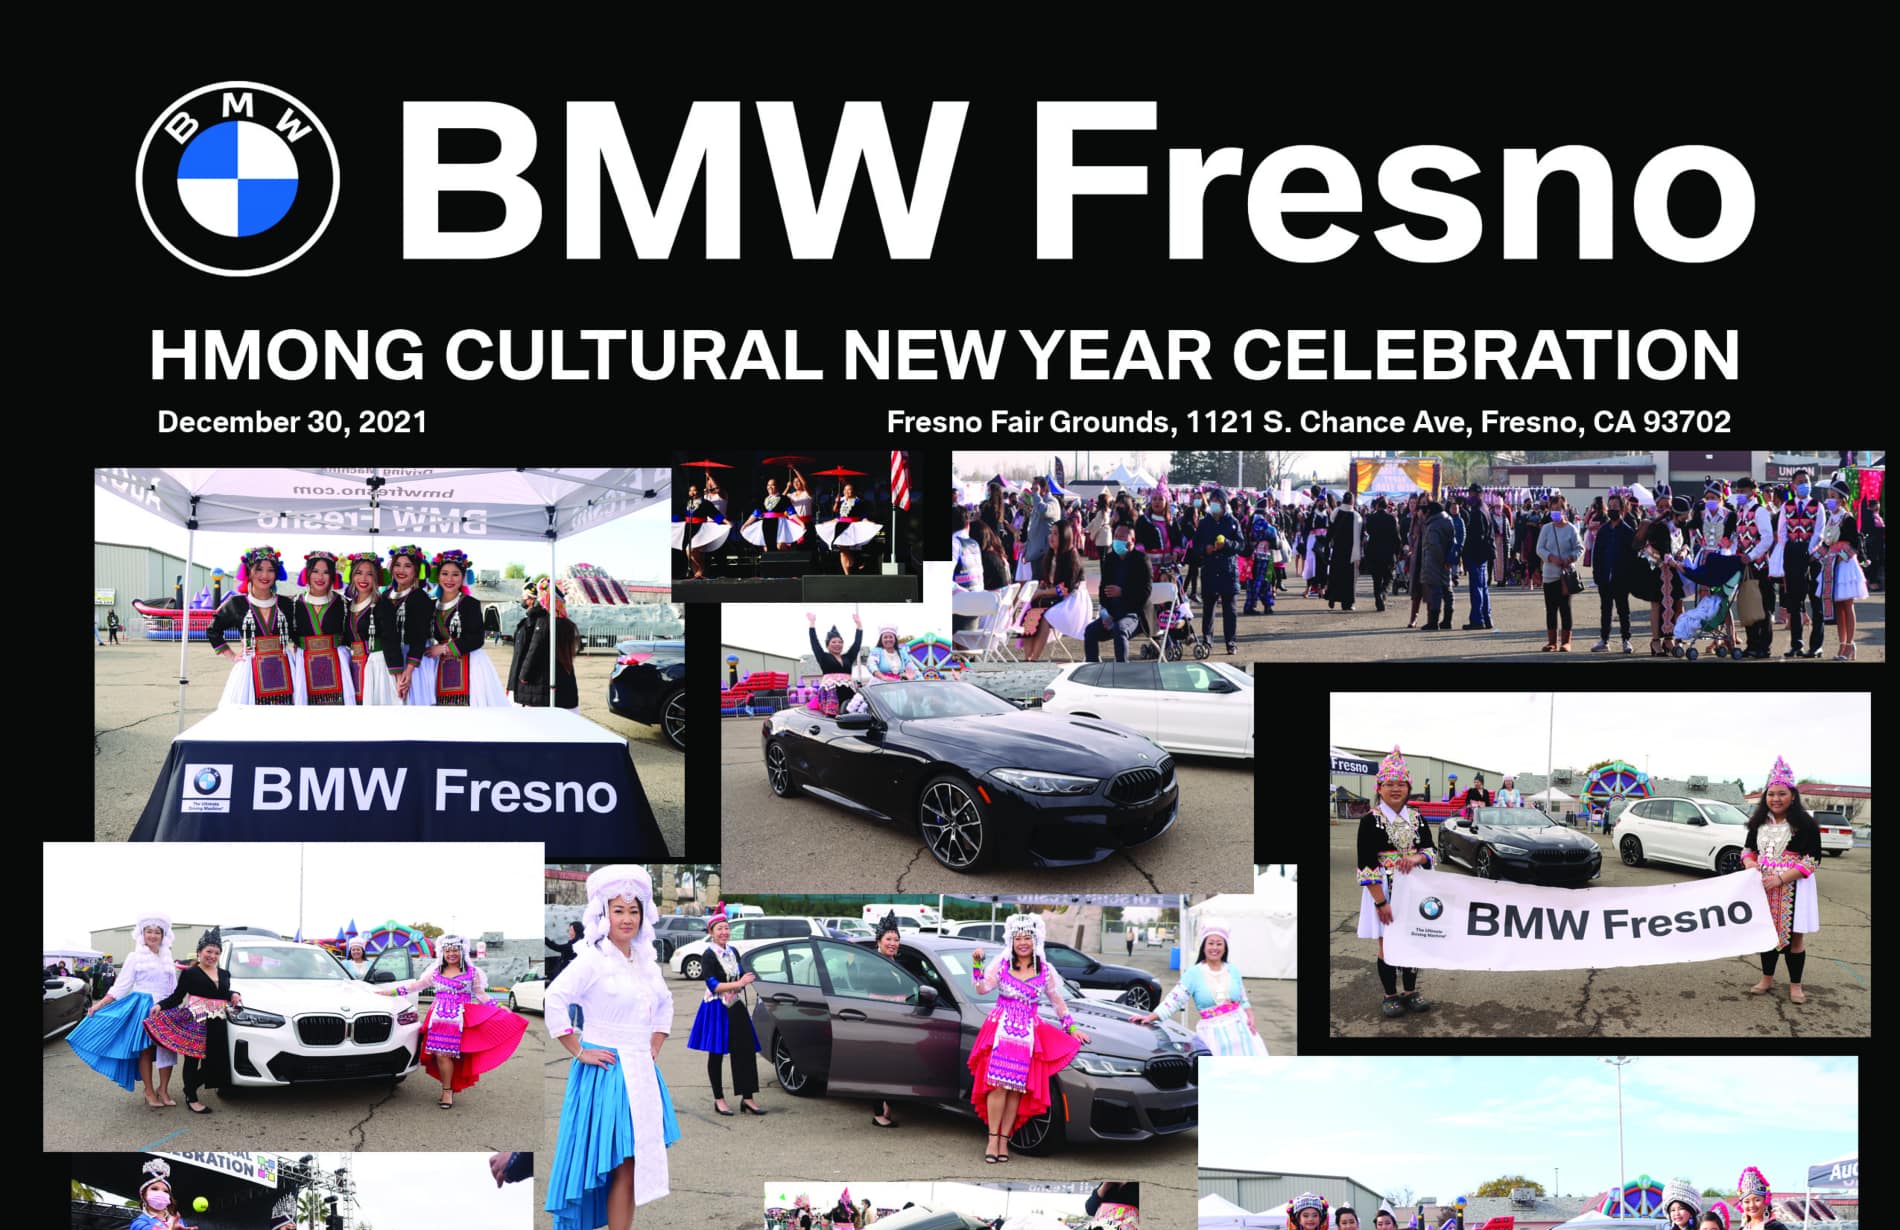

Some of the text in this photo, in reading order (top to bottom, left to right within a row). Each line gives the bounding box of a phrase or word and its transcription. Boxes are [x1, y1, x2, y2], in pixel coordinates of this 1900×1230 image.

[1331, 756, 1369, 774] Fresno
[252, 766, 618, 814] BMW Fresno
[1467, 900, 1753, 941] BMW Fresno
